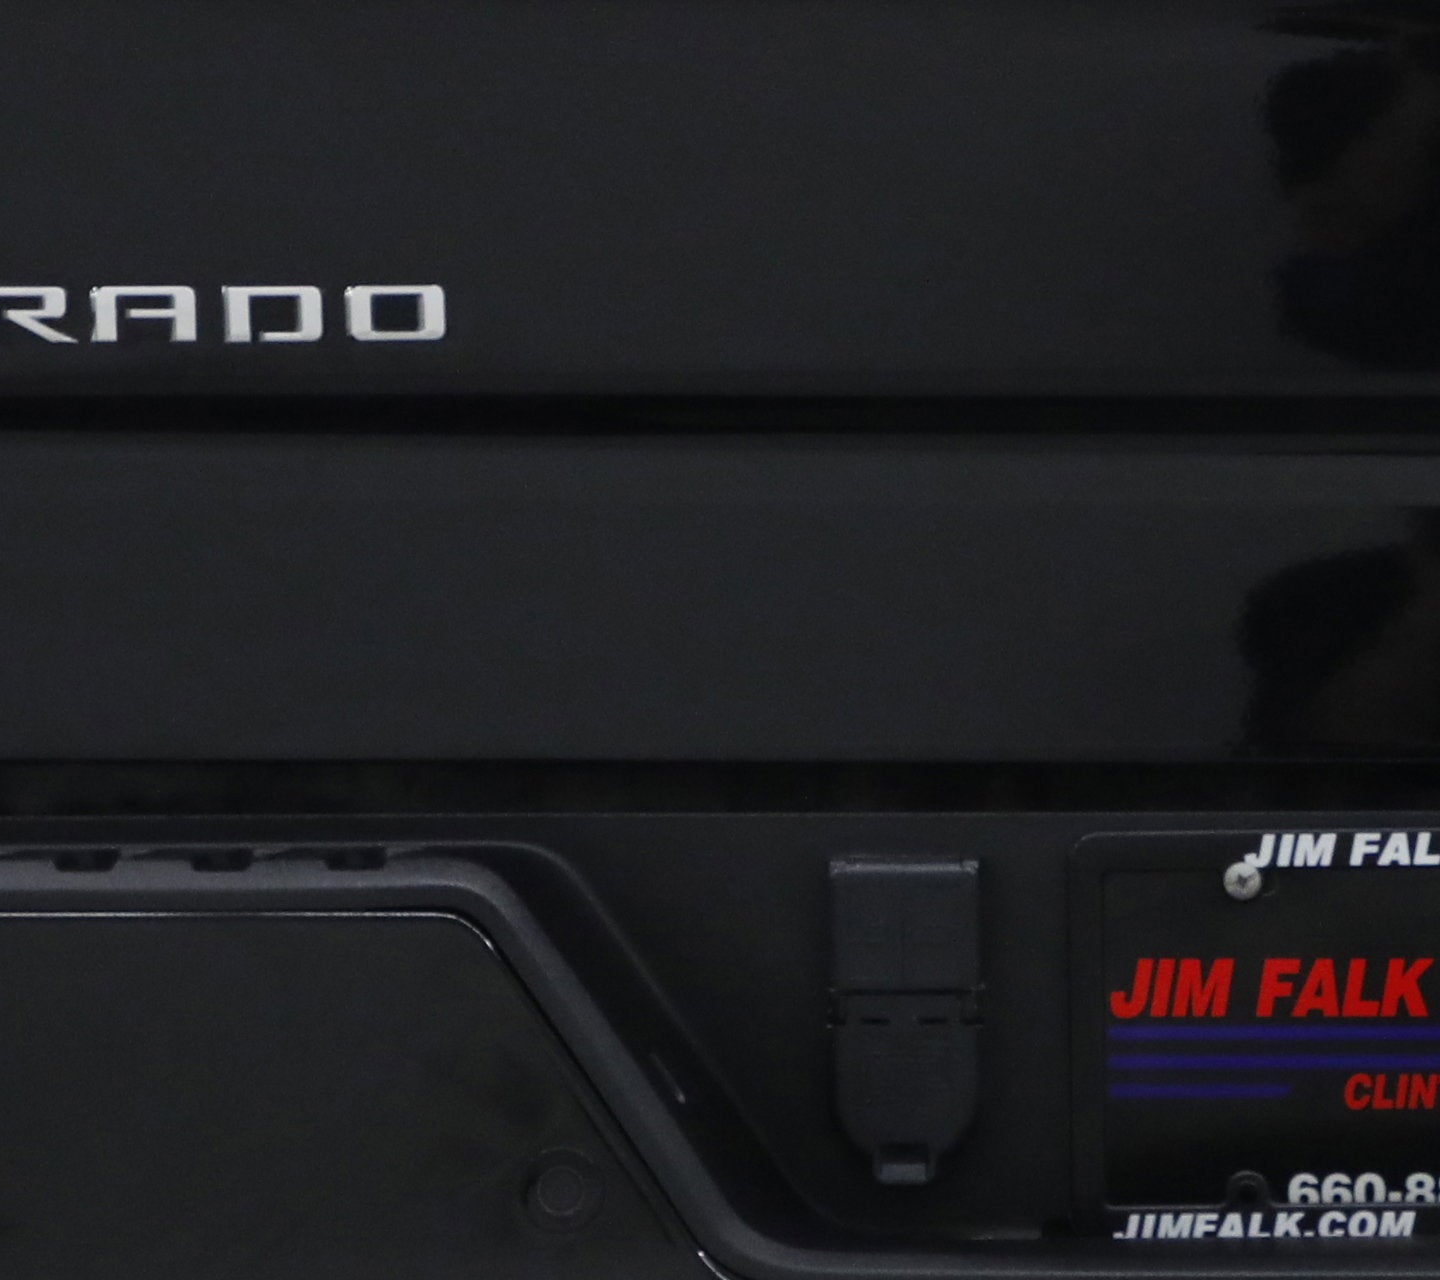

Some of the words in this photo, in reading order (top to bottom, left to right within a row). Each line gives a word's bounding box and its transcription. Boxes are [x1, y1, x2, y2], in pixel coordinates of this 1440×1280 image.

[1244, 833, 1337, 867] JIM
[1110, 957, 1233, 1019] JIM
[1257, 957, 1433, 1018] FALK
[1113, 1210, 1417, 1238] JIMFALK.COM
